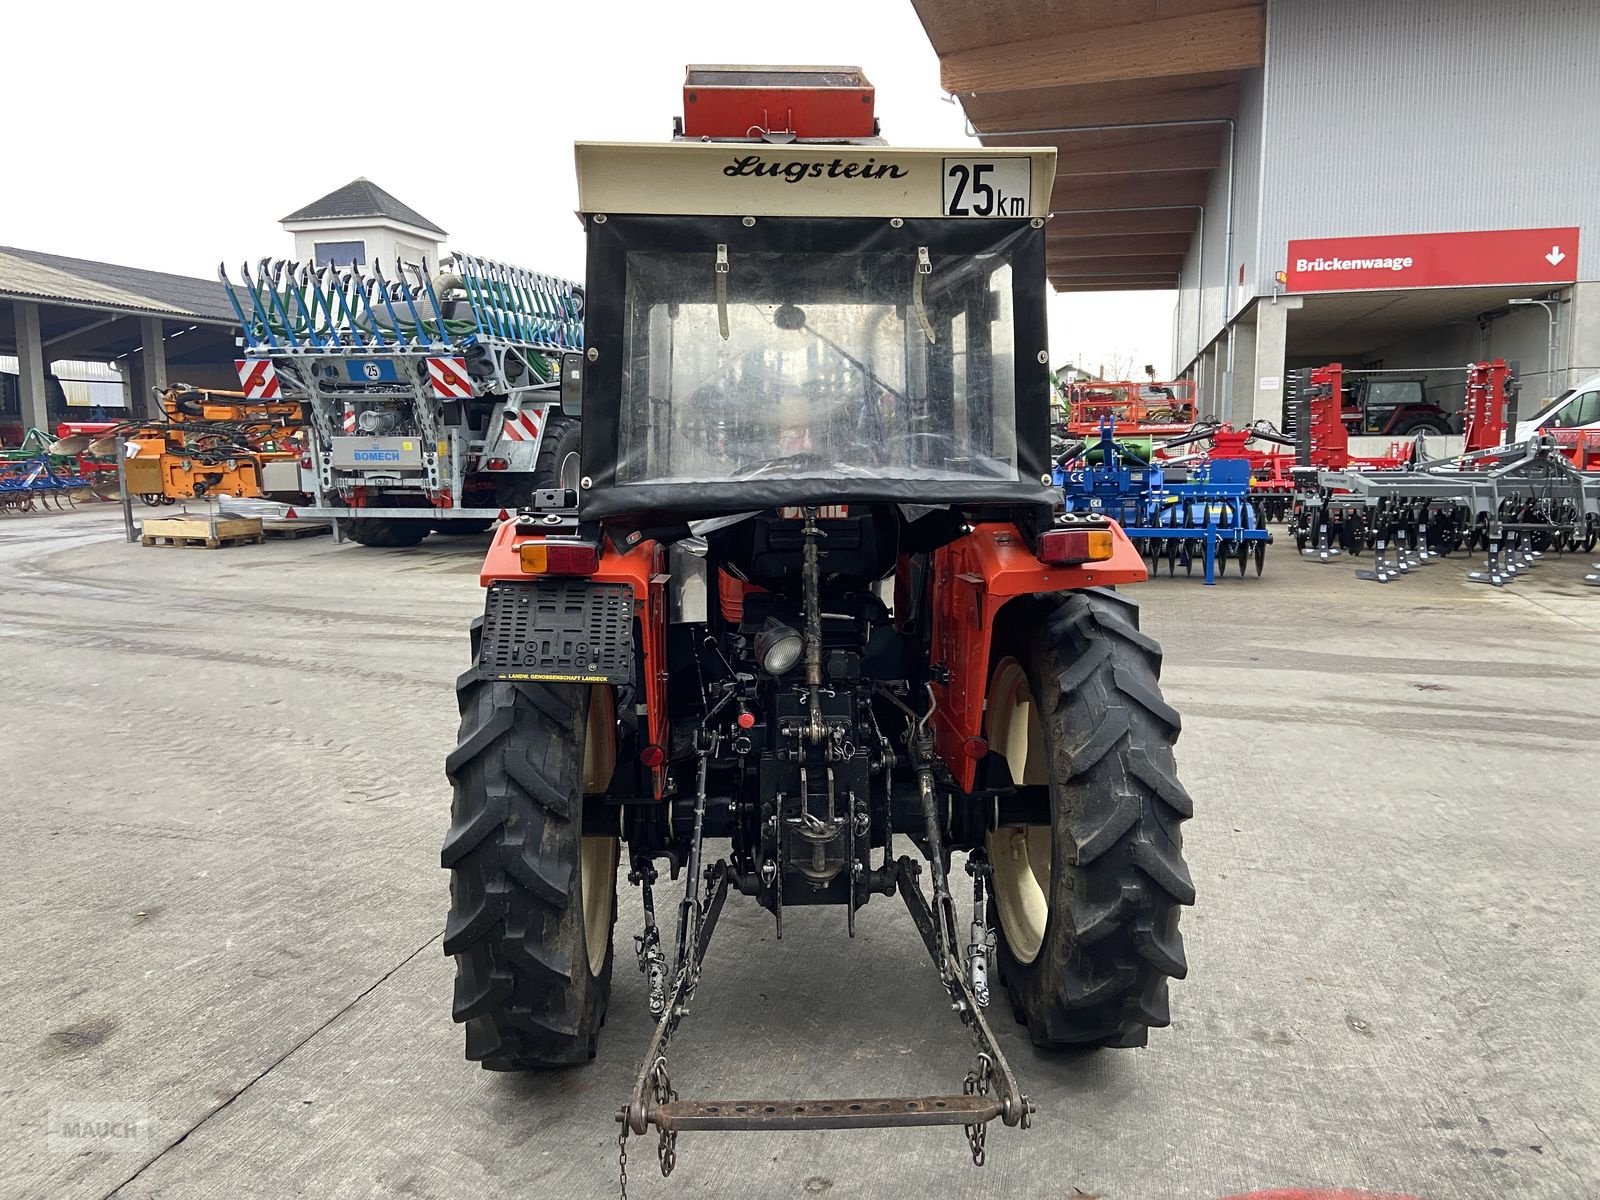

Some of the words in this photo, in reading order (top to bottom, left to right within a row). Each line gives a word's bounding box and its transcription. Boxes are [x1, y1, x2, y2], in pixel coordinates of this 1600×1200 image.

[724, 156, 909, 183] Lugstein
[1296, 257, 1413, 272] Brückenwaage
[366, 365, 378, 377] 25
[354, 452, 400, 461] BOMECH
